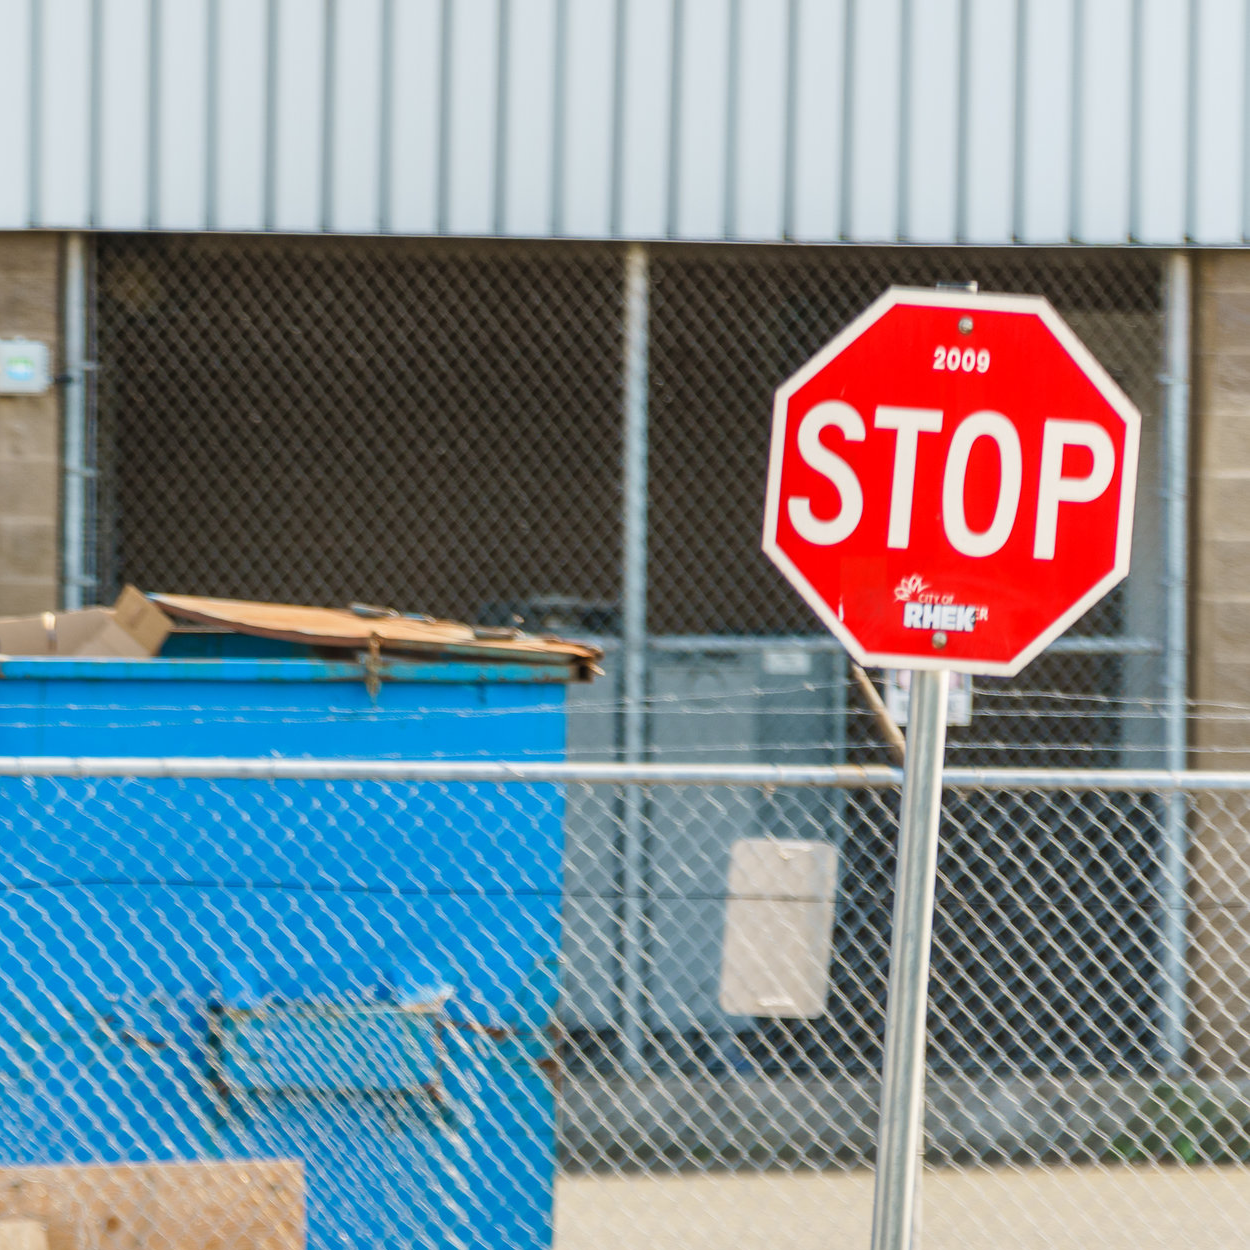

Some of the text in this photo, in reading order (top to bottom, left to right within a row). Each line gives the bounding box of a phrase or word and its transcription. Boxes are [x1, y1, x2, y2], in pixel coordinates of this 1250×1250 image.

[932, 345, 990, 373] 2009
[788, 399, 1115, 560] STOP
[918, 593, 940, 605] CITY
[903, 602, 976, 632] RHEK
